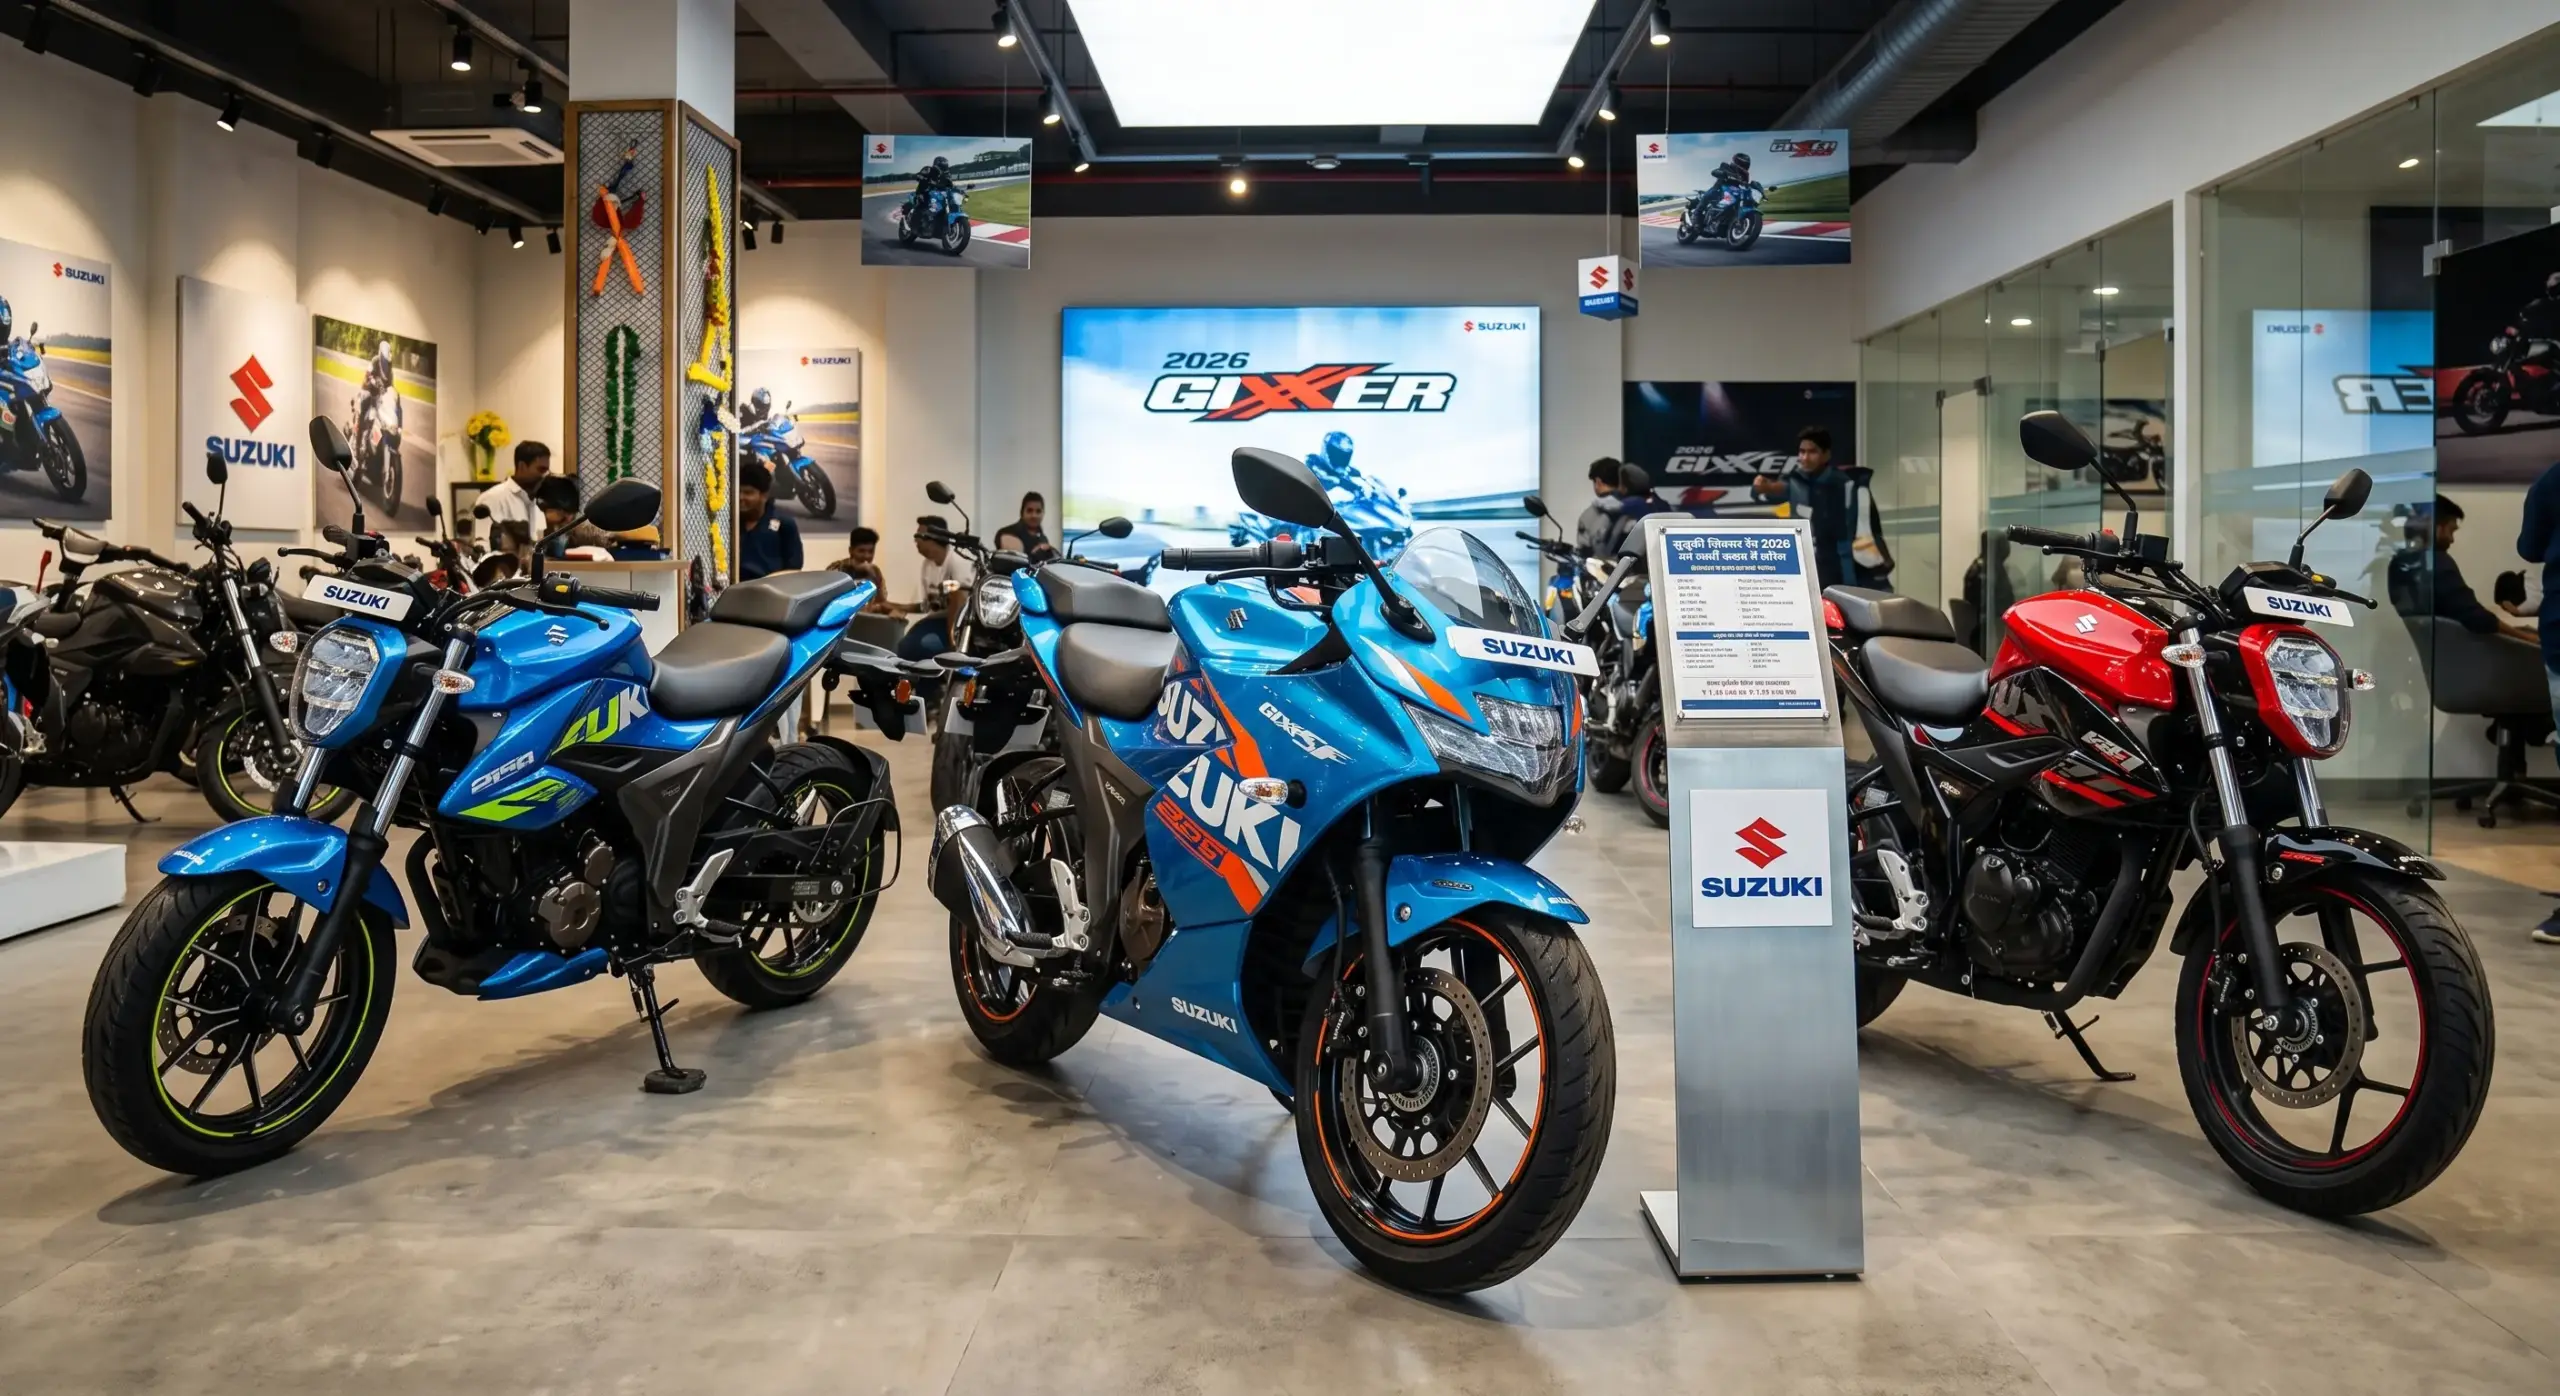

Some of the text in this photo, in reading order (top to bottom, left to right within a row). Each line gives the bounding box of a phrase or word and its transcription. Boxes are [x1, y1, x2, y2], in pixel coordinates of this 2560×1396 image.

[65, 267, 105, 285] SUZUKI
[1478, 322, 1526, 331] SUZUKI
[811, 356, 852, 365] SUZUKI
[1163, 352, 1250, 369] 2026
[1143, 363, 1458, 422] GIXXER
[206, 436, 295, 469] SUZUKI
[1761, 538, 1791, 549] 2026
[324, 585, 390, 610] SUZUKI
[2267, 596, 2332, 618] SUZUKI
[1482, 638, 1575, 666] SUZUKI
[1158, 681, 1227, 745] SUZ
[1701, 877, 1823, 898] SUZUKI
[1171, 996, 1238, 1034] SUZUKI
